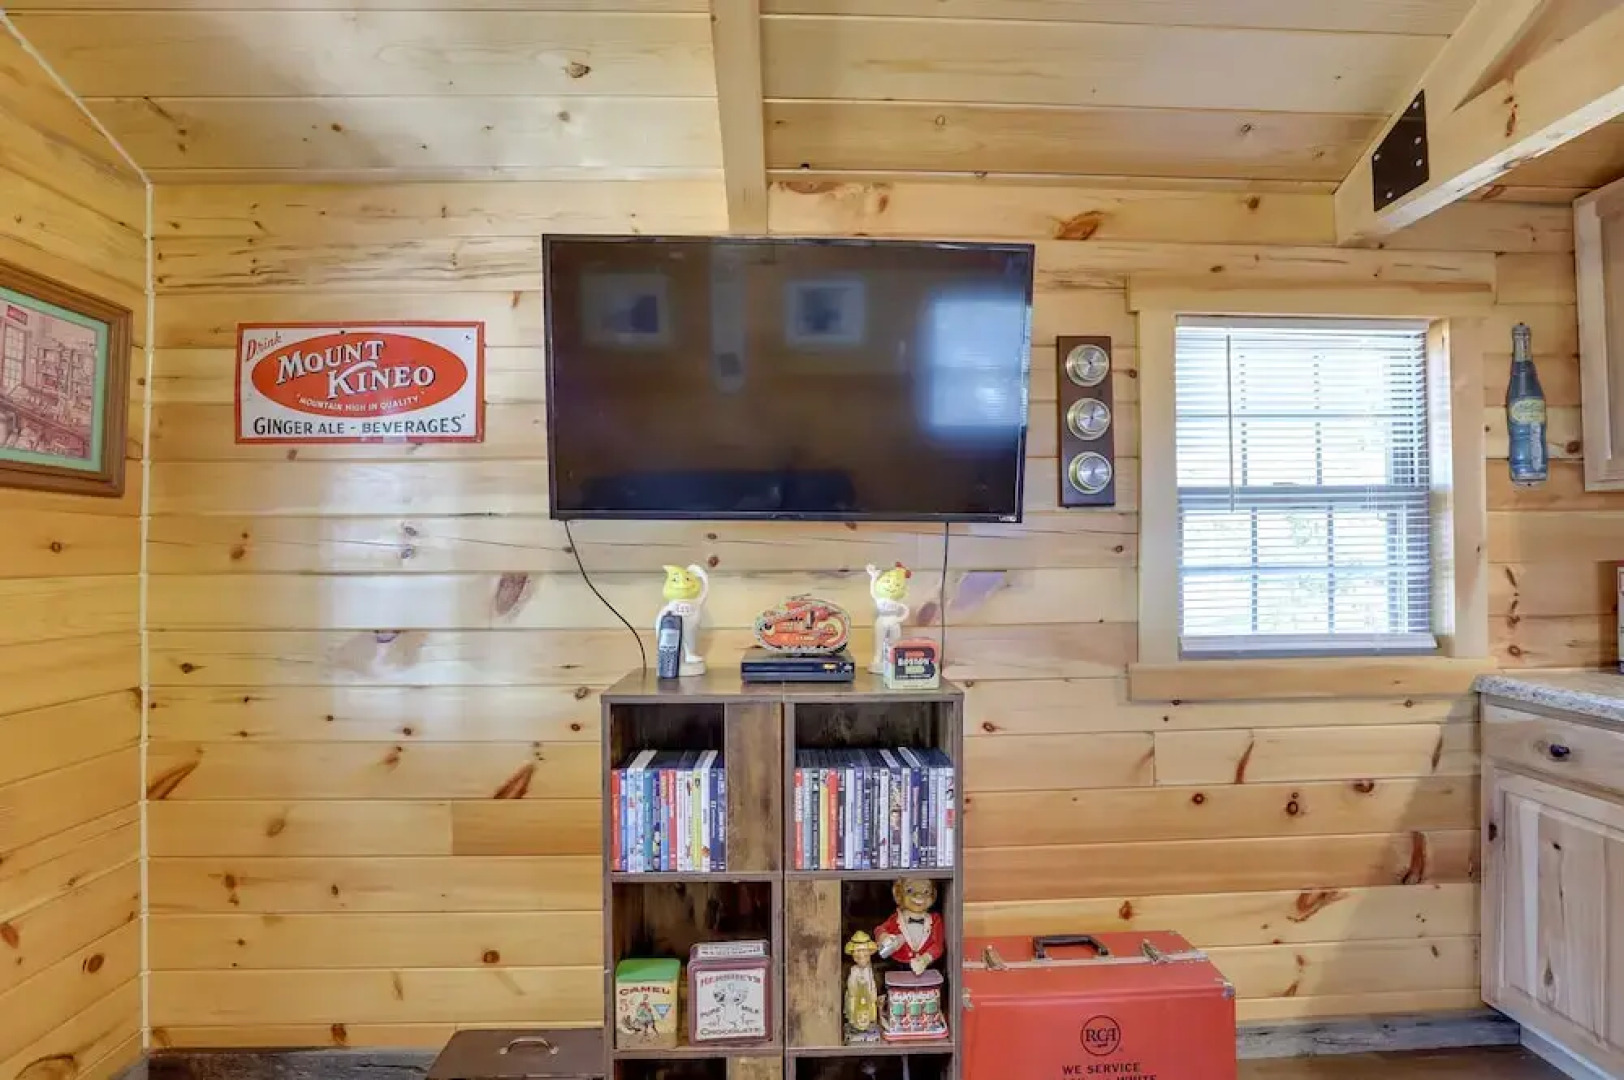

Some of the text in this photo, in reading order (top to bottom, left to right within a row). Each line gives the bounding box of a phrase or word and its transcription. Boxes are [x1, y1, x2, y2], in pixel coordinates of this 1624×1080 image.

[246, 330, 283, 361] Drink
[275, 340, 384, 386] MOUNT
[327, 360, 436, 400] KINEO
[345, 402, 366, 412] HIGH
[368, 402, 378, 411] IN
[253, 416, 313, 436] GINGER
[317, 421, 346, 435] ALE
[619, 985, 670, 996] CAMEL
[1085, 1027, 1117, 1048] RCA
[1062, 1062, 1140, 1075] WE SERVICE
